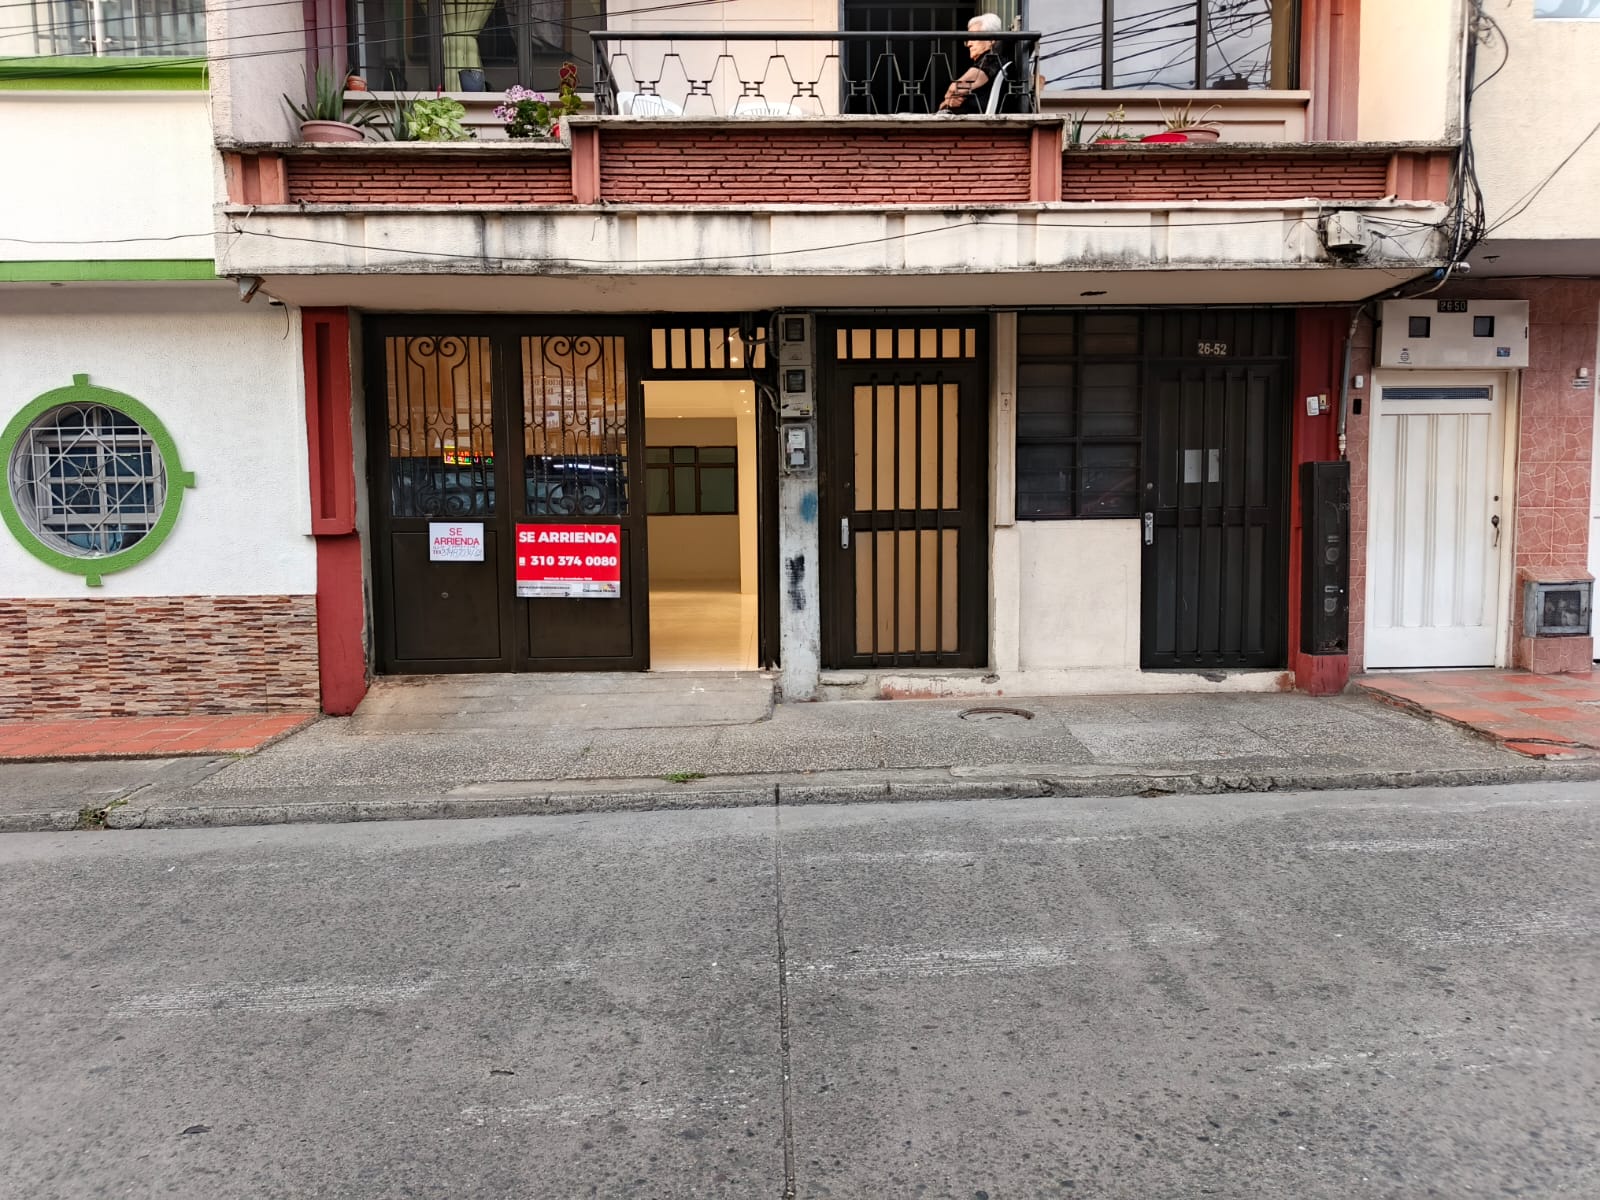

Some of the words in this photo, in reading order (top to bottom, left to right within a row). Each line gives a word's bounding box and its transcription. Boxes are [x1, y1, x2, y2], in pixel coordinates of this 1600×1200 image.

[1198, 343, 1227, 355] 26-52
[449, 527, 463, 536] SE
[519, 531, 536, 543] SE
[538, 531, 617, 544] ARRIENDA
[434, 537, 480, 546] ARRIENDA
[530, 555, 555, 567] 310
[557, 555, 583, 567] 374
[585, 556, 617, 567] 0080
